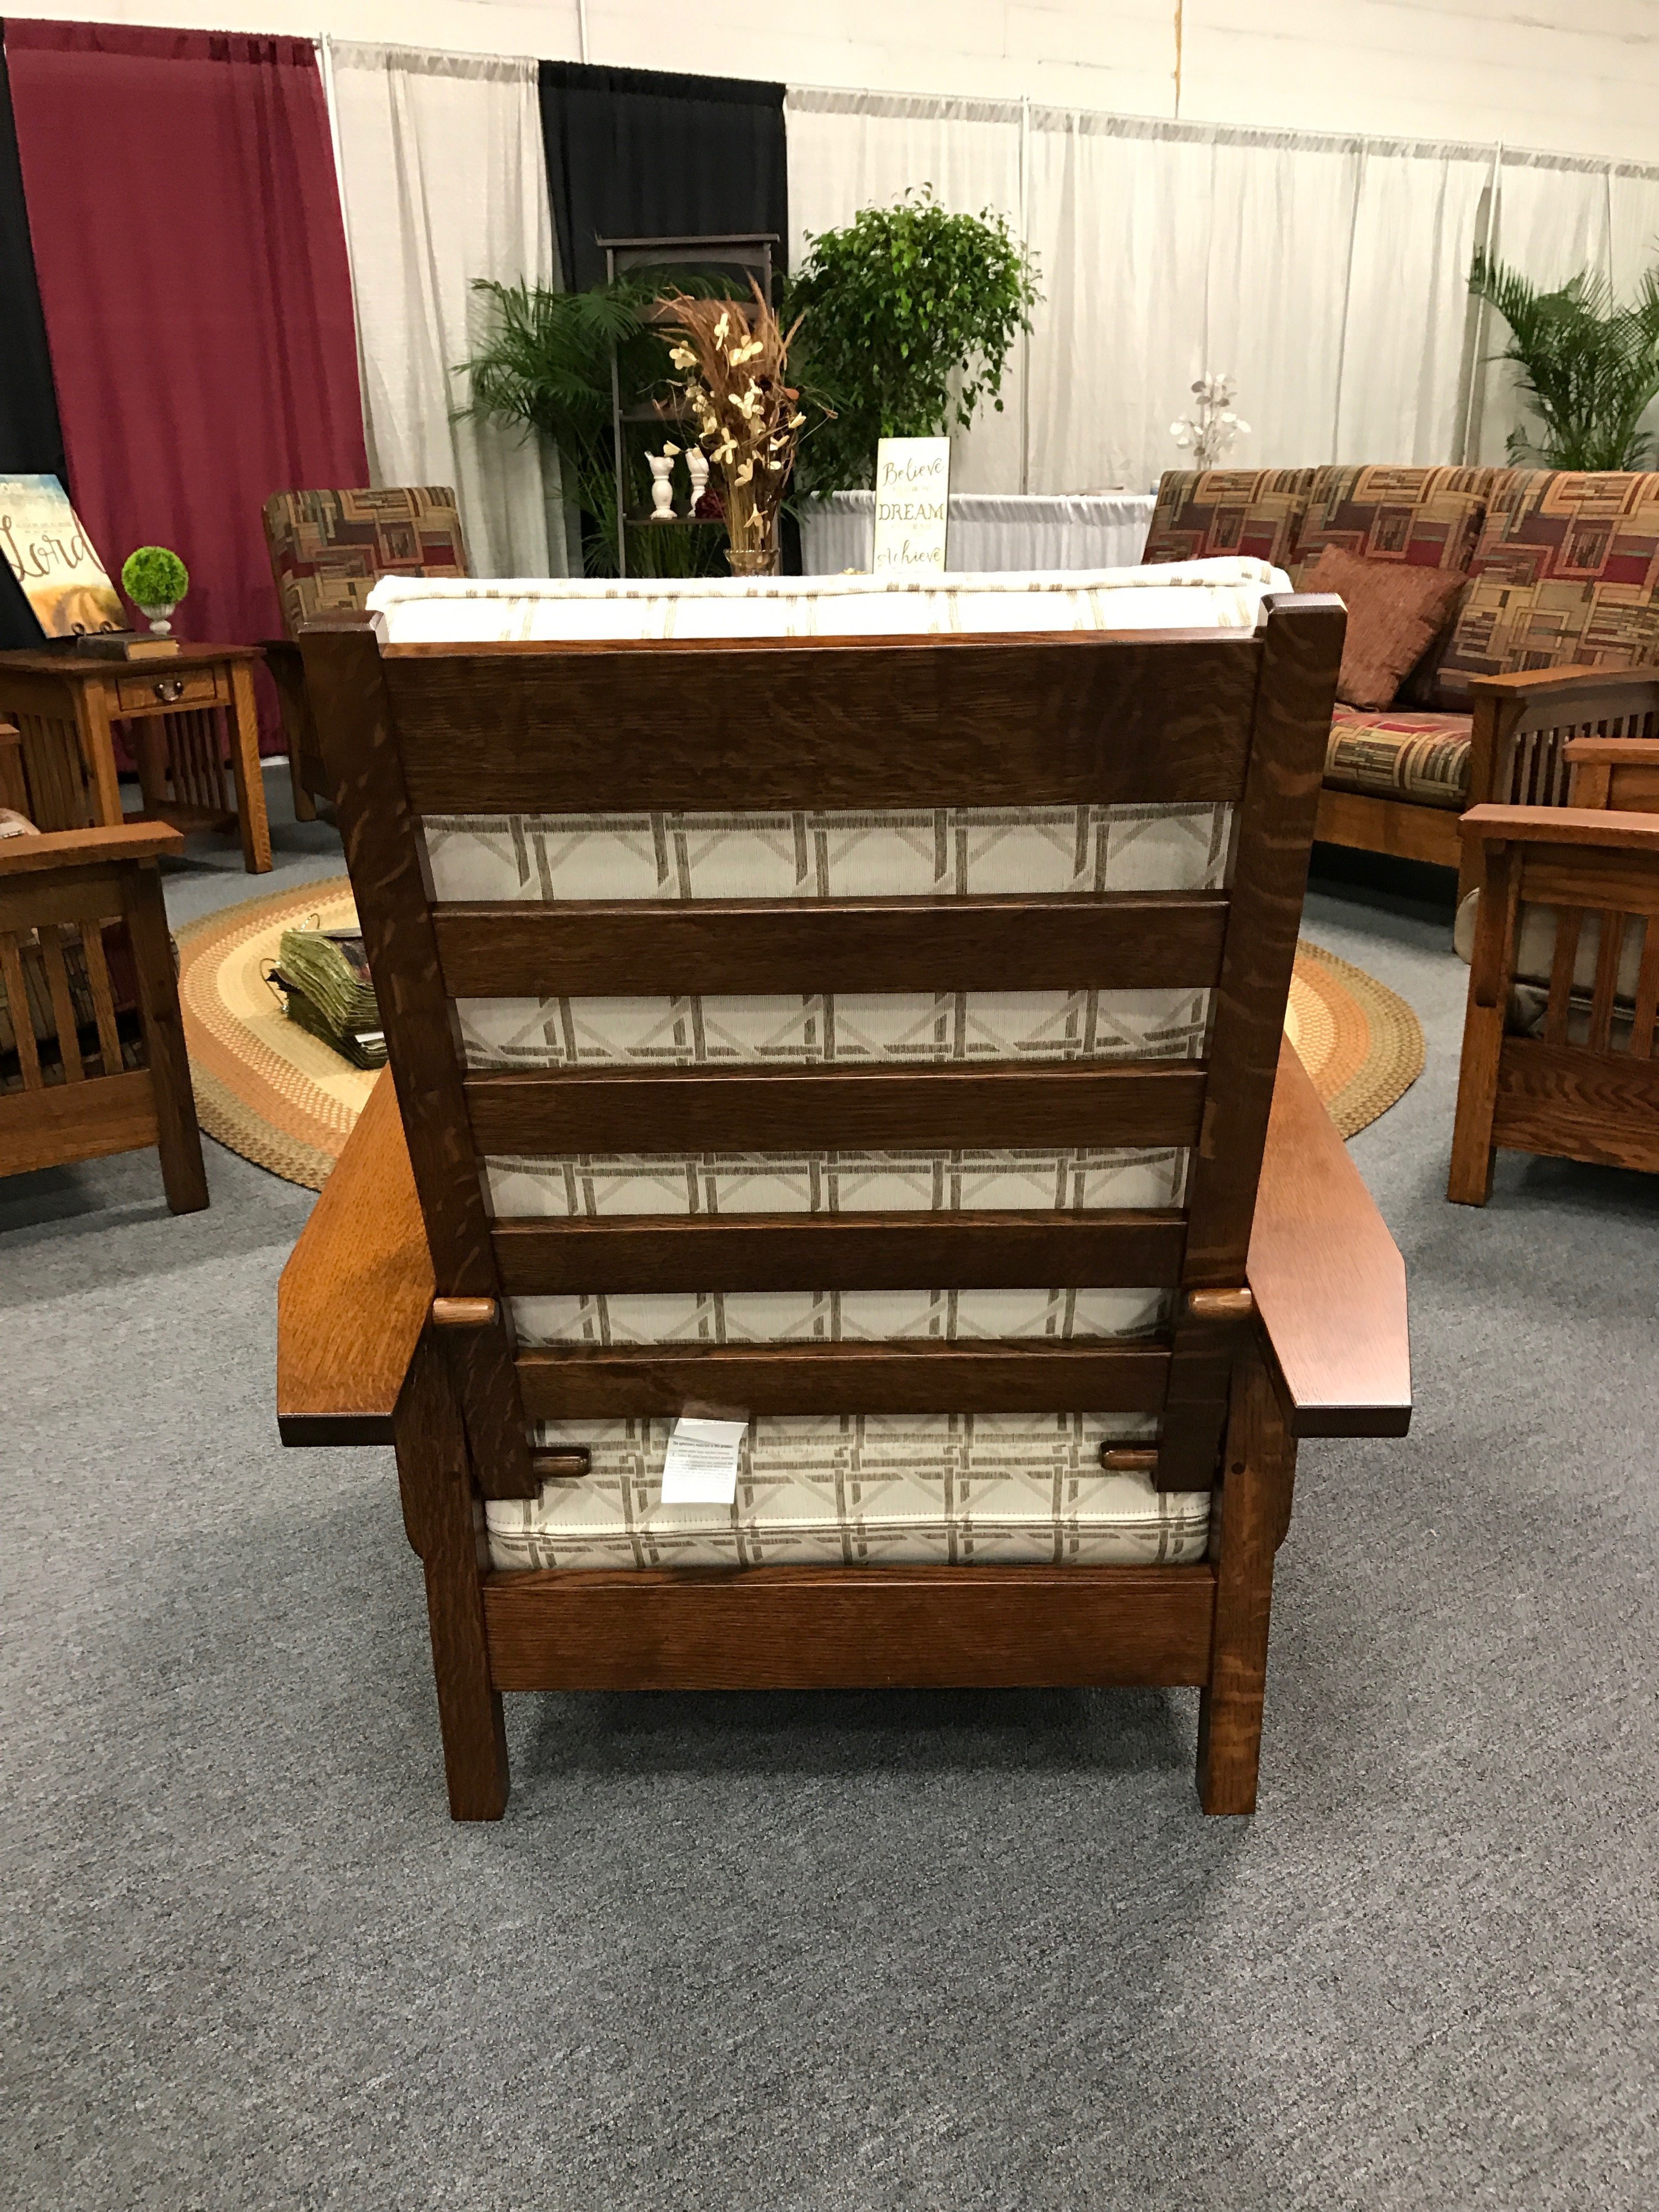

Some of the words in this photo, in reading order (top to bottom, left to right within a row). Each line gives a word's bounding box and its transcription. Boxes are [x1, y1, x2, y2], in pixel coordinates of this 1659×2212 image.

[882, 458, 944, 487] Believe
[878, 503, 945, 521] DREAM
[0, 506, 106, 582] Lord
[877, 539, 941, 569] Achieve
